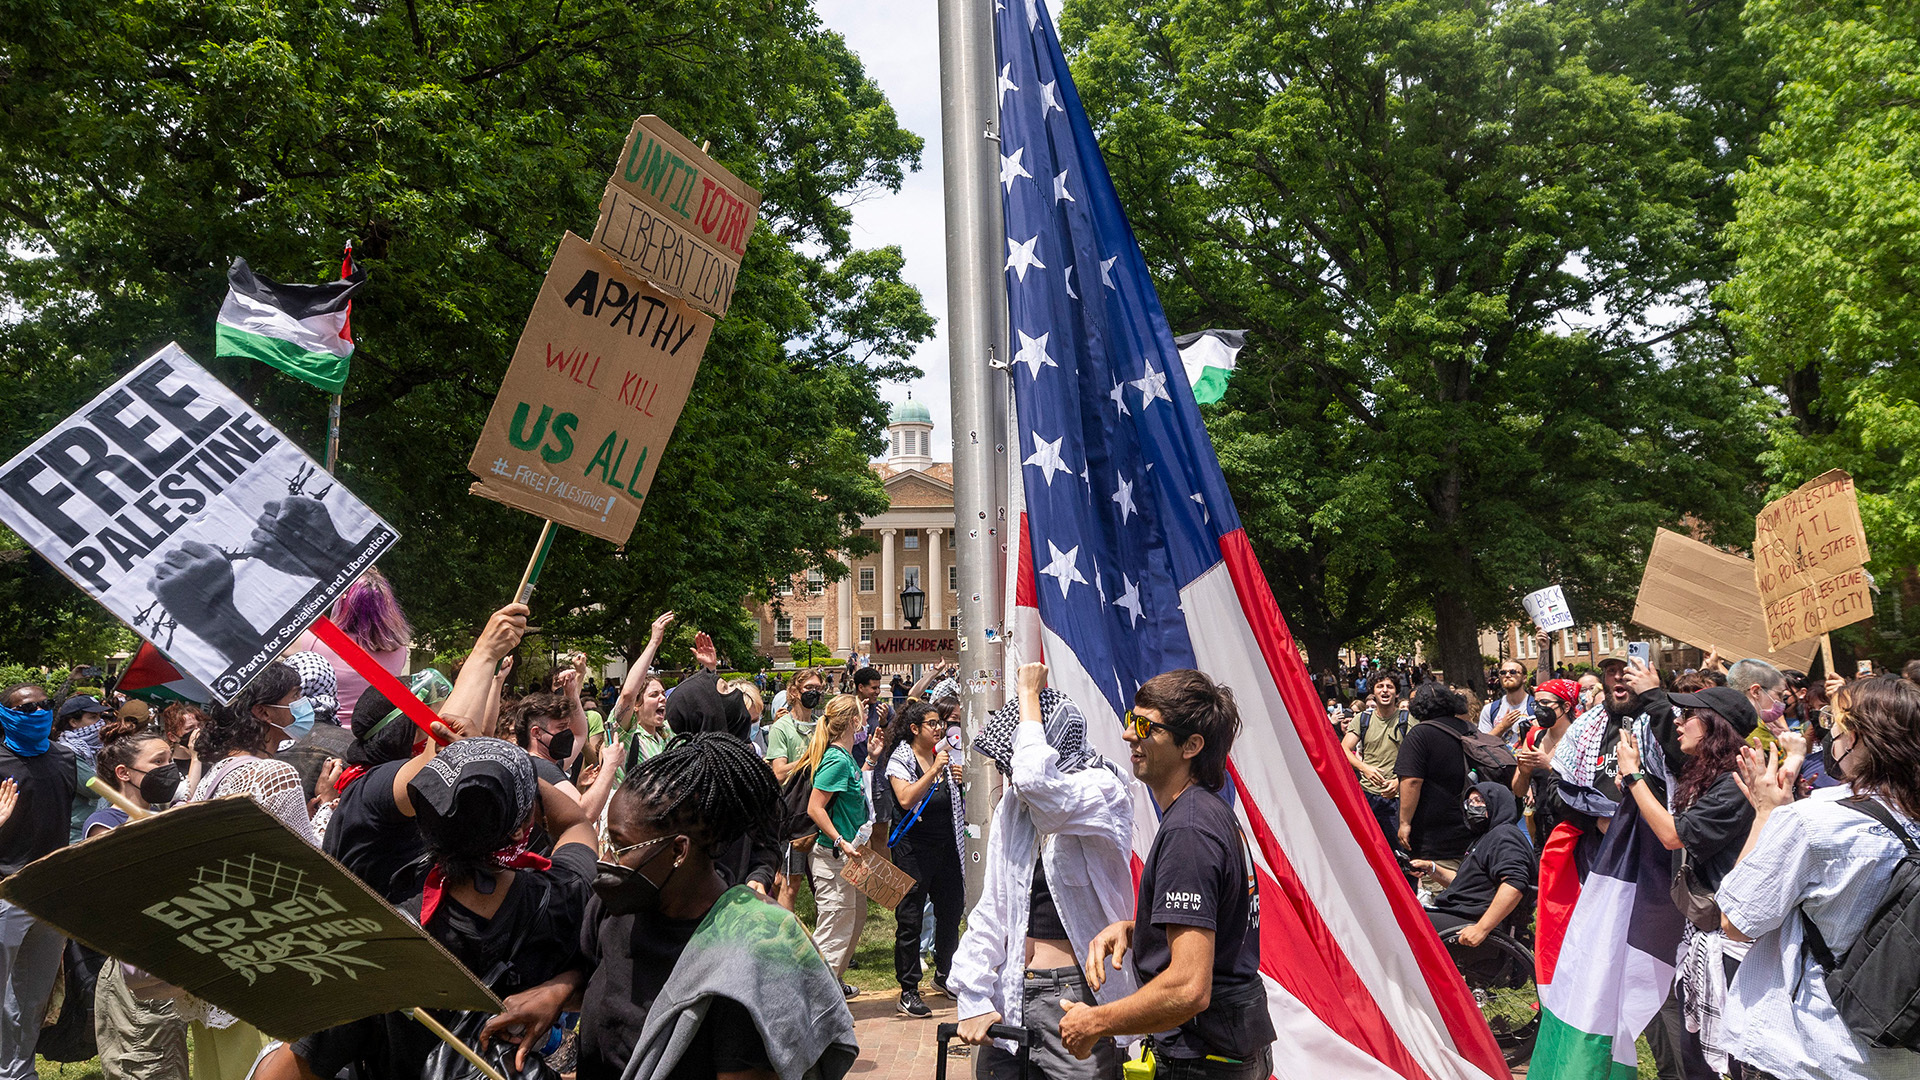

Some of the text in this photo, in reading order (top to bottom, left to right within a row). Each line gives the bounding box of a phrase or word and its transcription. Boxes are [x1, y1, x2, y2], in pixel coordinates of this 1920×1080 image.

[624, 130, 750, 256] UNTIL TOTAL
[600, 191, 737, 313] LIBERATION
[564, 269, 696, 356] APATHY
[546, 342, 659, 418] WILL KILL
[2, 358, 233, 548] FREE
[508, 401, 649, 500] US ALL
[64, 411, 281, 593] PALESTINE
[1785, 478, 1852, 523] PALESTINE
[1759, 511, 1840, 569] TO ATL
[1534, 587, 1563, 608] BACK
[1761, 573, 1776, 594] NO
[1778, 551, 1818, 584] POLICE
[1765, 571, 1862, 625] FREE PALESTINE
[237, 530, 391, 679] Party for Socialism and Liberation
[1540, 611, 1571, 629] PALESTINE
[1770, 590, 1864, 648] STOP COP CITY
[845, 869, 858, 884] TO
[1166, 891, 1201, 903] NADIR
[141, 882, 256, 930] END
[176, 891, 348, 954] ISRAELI
[1165, 901, 1201, 911] CREW
[217, 918, 383, 971] APARTHEID
